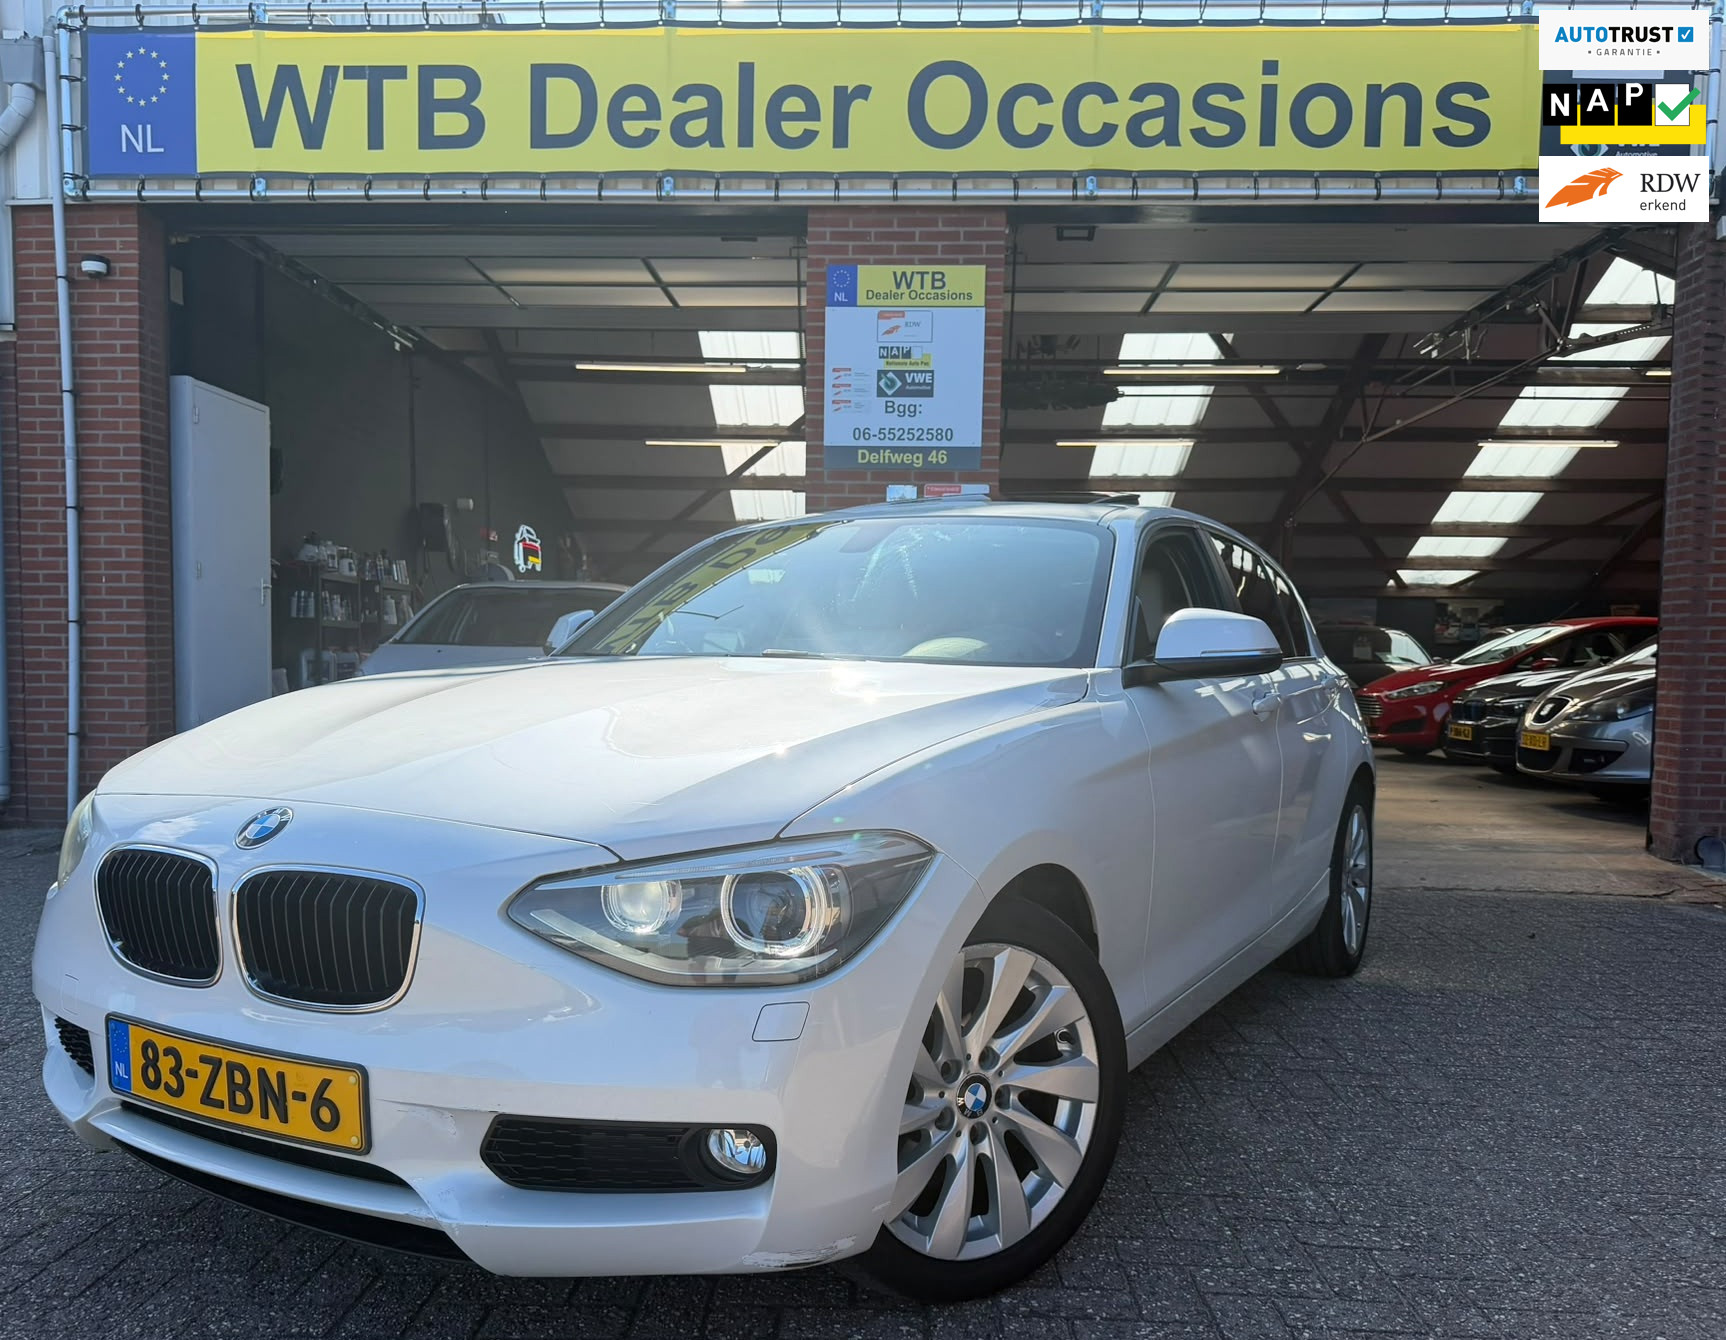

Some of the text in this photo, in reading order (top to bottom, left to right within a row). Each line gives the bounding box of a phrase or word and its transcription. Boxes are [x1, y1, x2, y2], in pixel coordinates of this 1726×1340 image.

[235, 59, 1491, 150] WTB Dealer Occasions
[121, 124, 164, 153] NL
[893, 271, 946, 290] WTB
[834, 292, 848, 302] NL
[866, 289, 973, 301] Dealer Occasions
[880, 346, 910, 357] NAP
[905, 372, 933, 384] VWE
[884, 400, 923, 418] Bgg:
[852, 427, 954, 442] 06-55252580
[857, 449, 948, 467] Delfweg 46
[114, 1060, 129, 1080] NL
[140, 1038, 341, 1132] 83-ZBN-6
